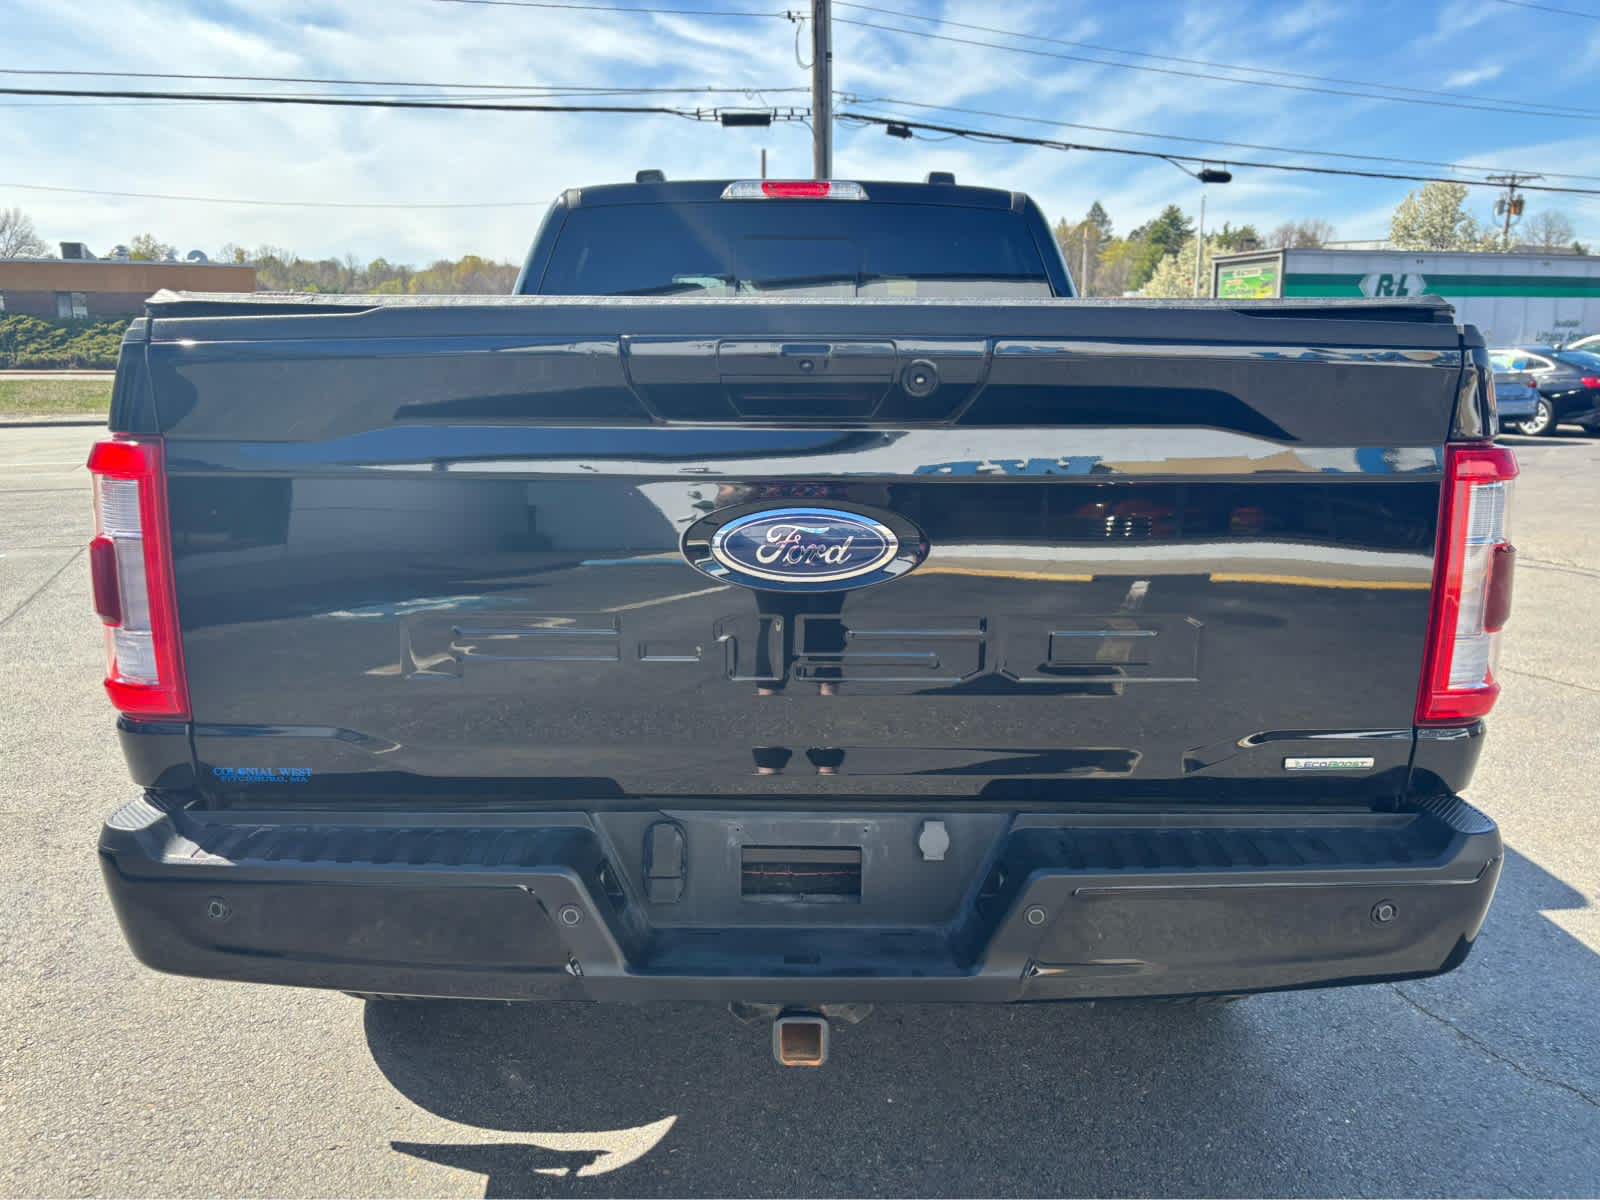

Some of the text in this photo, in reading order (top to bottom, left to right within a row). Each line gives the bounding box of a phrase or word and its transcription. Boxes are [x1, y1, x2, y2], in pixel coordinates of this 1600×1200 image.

[756, 524, 854, 565] Ford
[400, 614, 1200, 682] F-150
[279, 768, 312, 776] WEST
